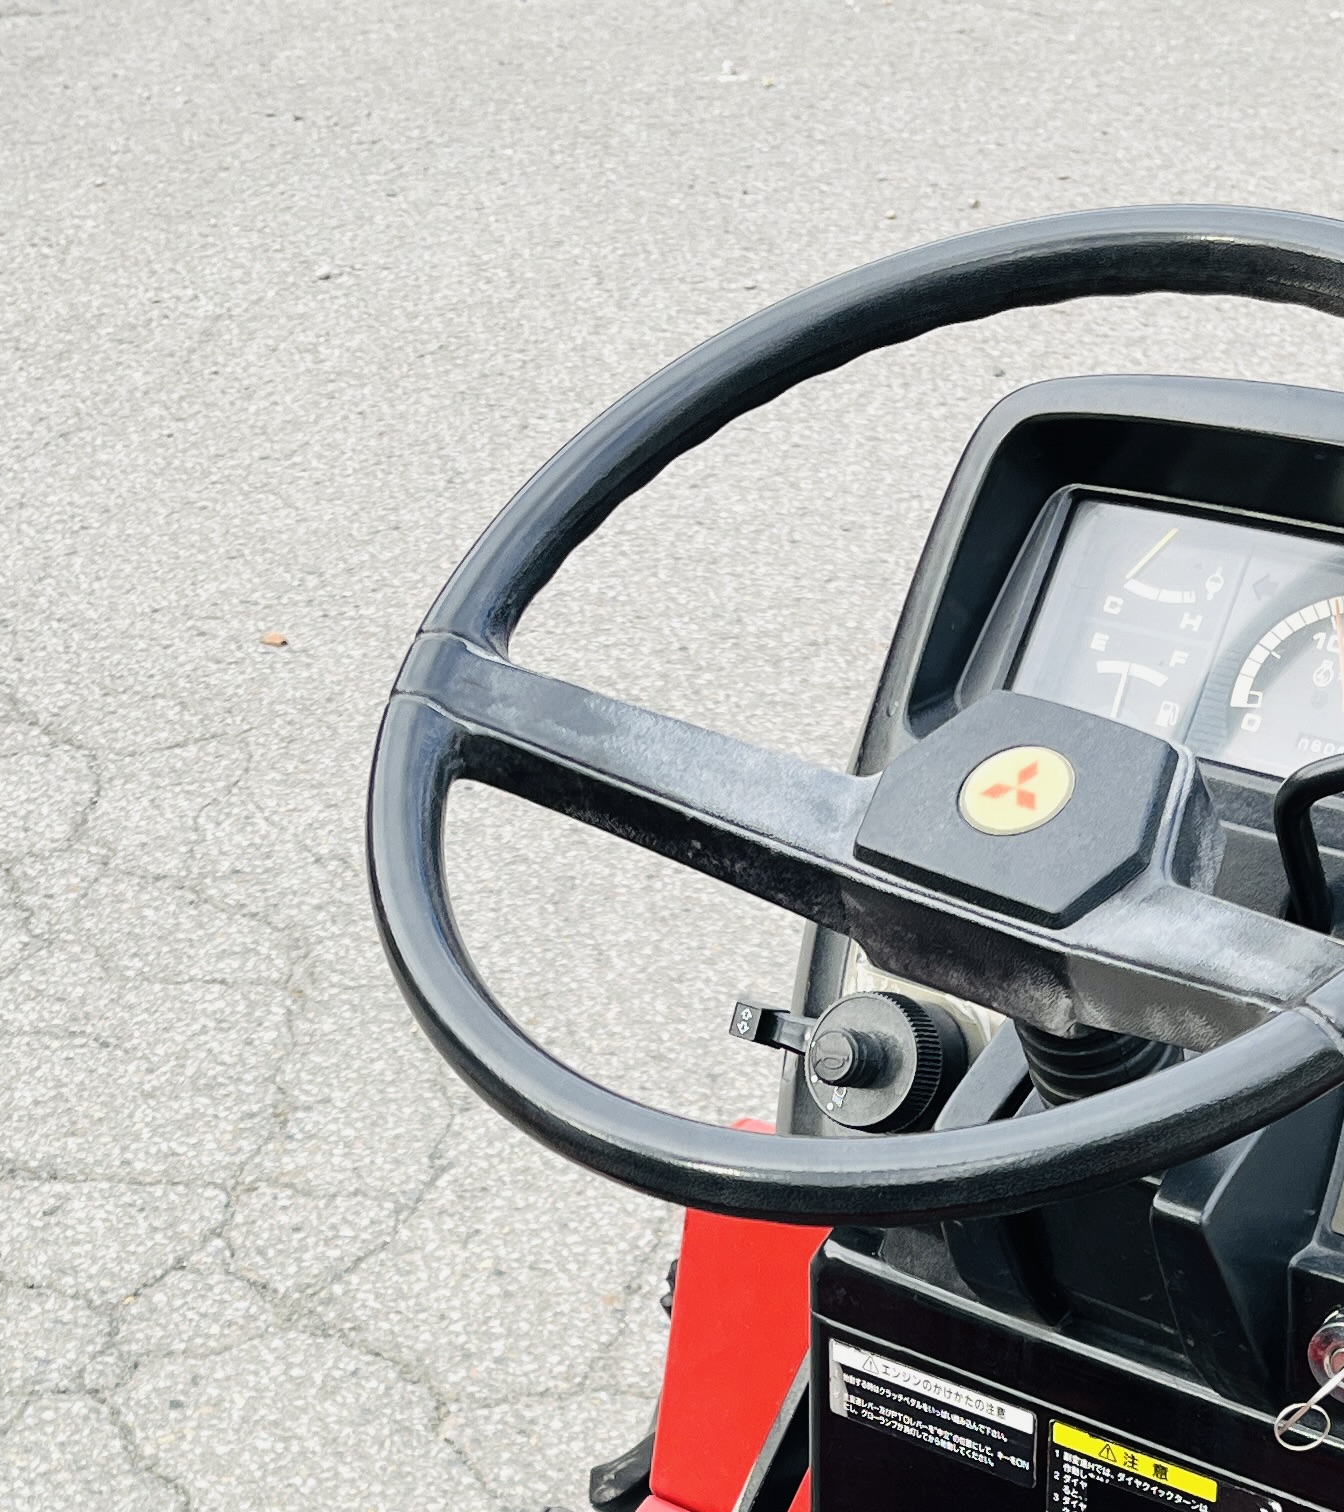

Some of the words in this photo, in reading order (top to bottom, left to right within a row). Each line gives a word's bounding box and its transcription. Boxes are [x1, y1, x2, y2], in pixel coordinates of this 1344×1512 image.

[1103, 595, 1124, 615] C
[1180, 612, 1203, 632] H
[1090, 632, 1110, 652] E
[1169, 650, 1189, 667] F
[882, 1363, 1006, 1421] エンジンのかけかたの注意
[1123, 1451, 1169, 1482] 注意
